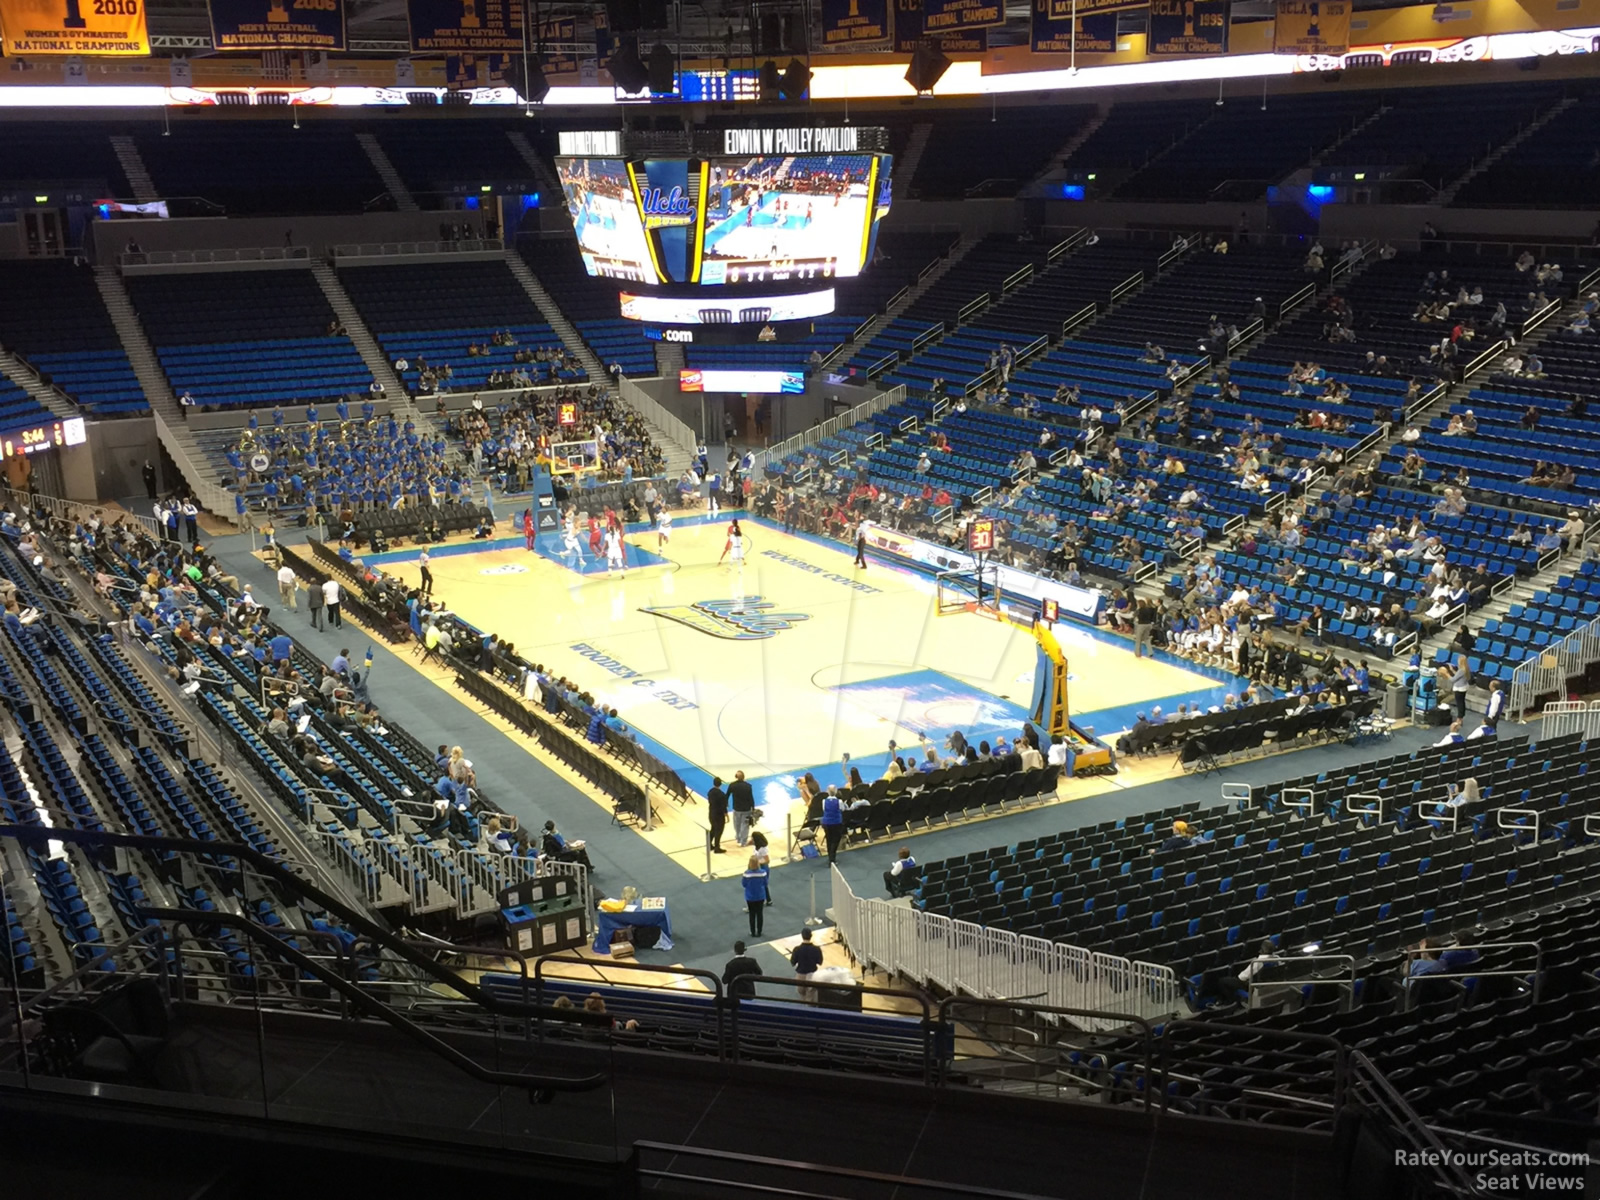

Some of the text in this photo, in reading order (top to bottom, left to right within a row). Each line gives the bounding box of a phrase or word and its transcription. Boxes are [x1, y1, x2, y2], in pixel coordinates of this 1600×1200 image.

[93, 0, 137, 15] 2010
[293, 0, 336, 10] 2006
[1151, 1, 1183, 15] UCLA
[1279, 2, 1308, 15] UCLA
[927, 6, 998, 28] NATIONAL CHAMPIONS
[1200, 13, 1224, 26] 1995
[24, 30, 128, 39] WOMEN'S GYMNASTICS
[266, 24, 317, 32] VOLLEYBALL
[14, 41, 140, 51] NATIONAL CHAMPIONS
[222, 34, 335, 45] NATIONAL CHAMPIONS
[418, 38, 524, 48] NATIONAL CHAMPIONS
[941, 40, 980, 50] CHAMPIONS
[1037, 40, 1112, 50] NATIONAL CHAMPIONS
[724, 127, 857, 154] EDWIN W PAULEY PAVILION
[641, 186, 697, 214] Ucla
[22, 427, 45, 444] 3:44
[972, 532, 991, 549] 30
[760, 550, 829, 573] WOODEN
[822, 573, 884, 593] COURT
[569, 643, 643, 679] WOODEN
